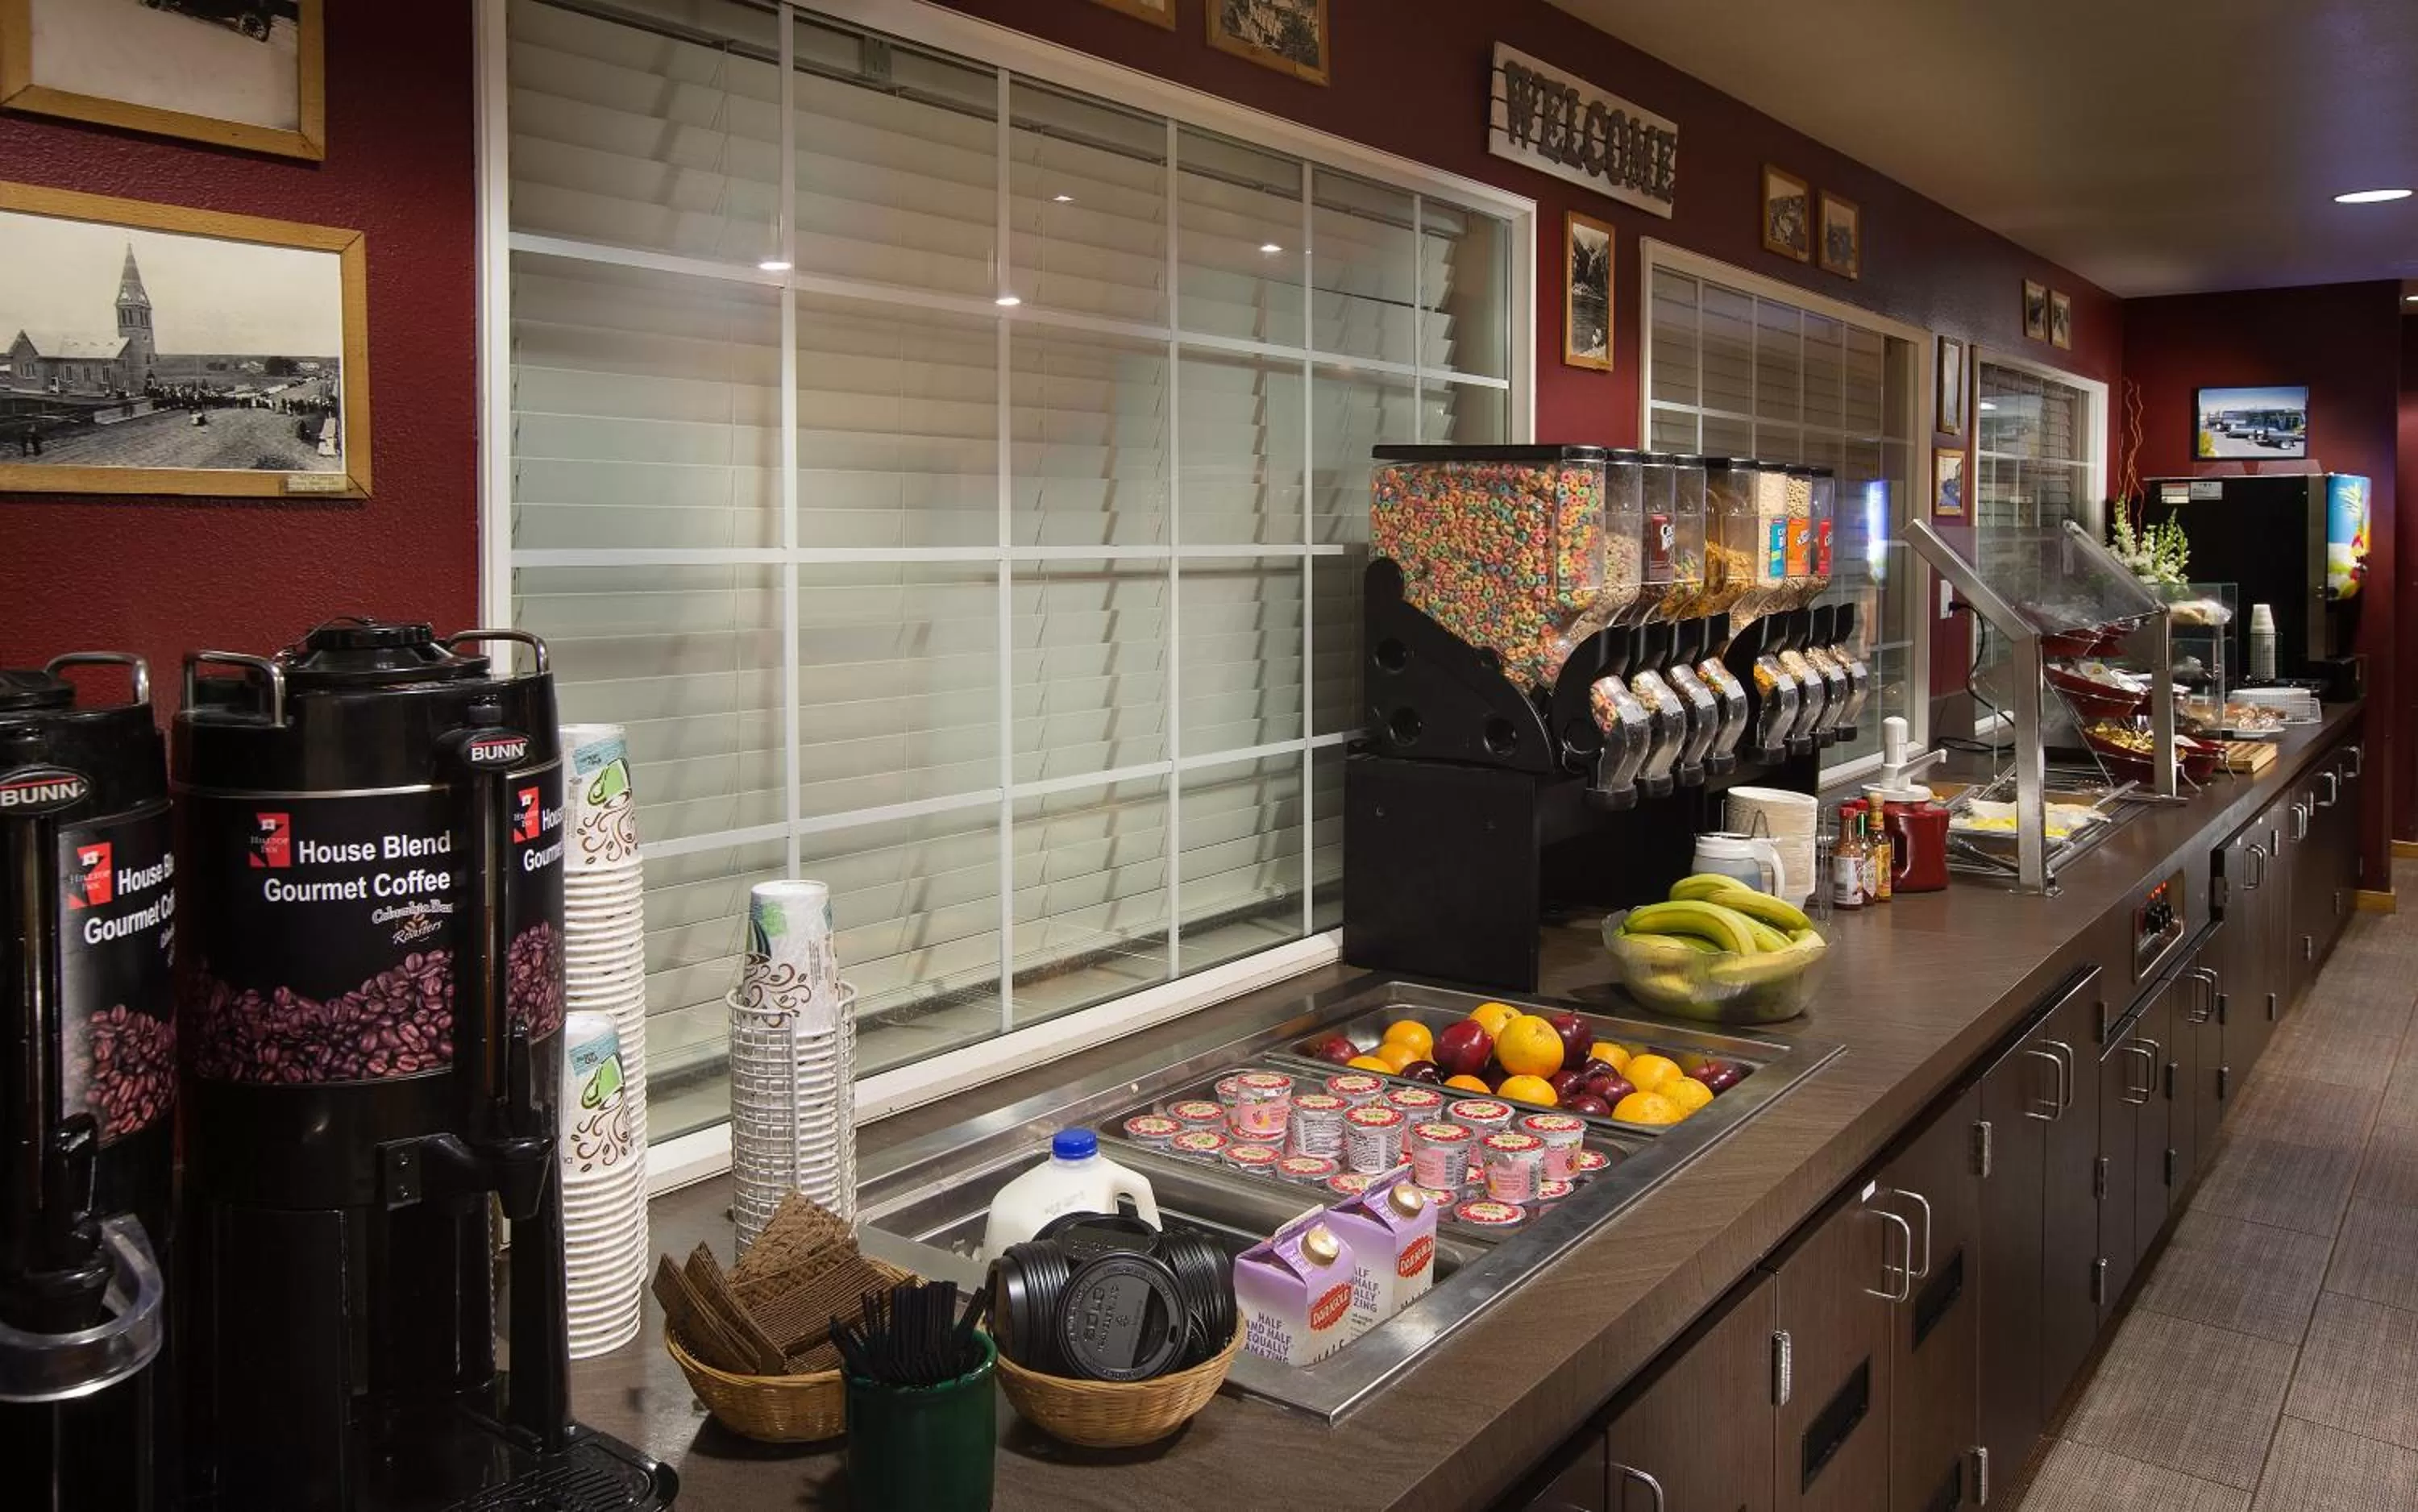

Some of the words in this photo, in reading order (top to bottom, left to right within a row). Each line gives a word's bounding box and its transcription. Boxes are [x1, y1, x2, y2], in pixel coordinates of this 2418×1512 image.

[1505, 60, 1676, 204] WELCOME
[472, 744, 525, 762] BUNN
[0, 783, 78, 807] BUNN
[298, 841, 376, 864] House
[383, 830, 451, 859] Blend
[118, 863, 163, 895] House
[264, 876, 367, 902] Gourmet
[373, 869, 451, 897] Coffee
[84, 899, 160, 945] Gourmet
[1258, 1312, 1282, 1330] HALF
[1248, 1331, 1289, 1356] EQUALLY
